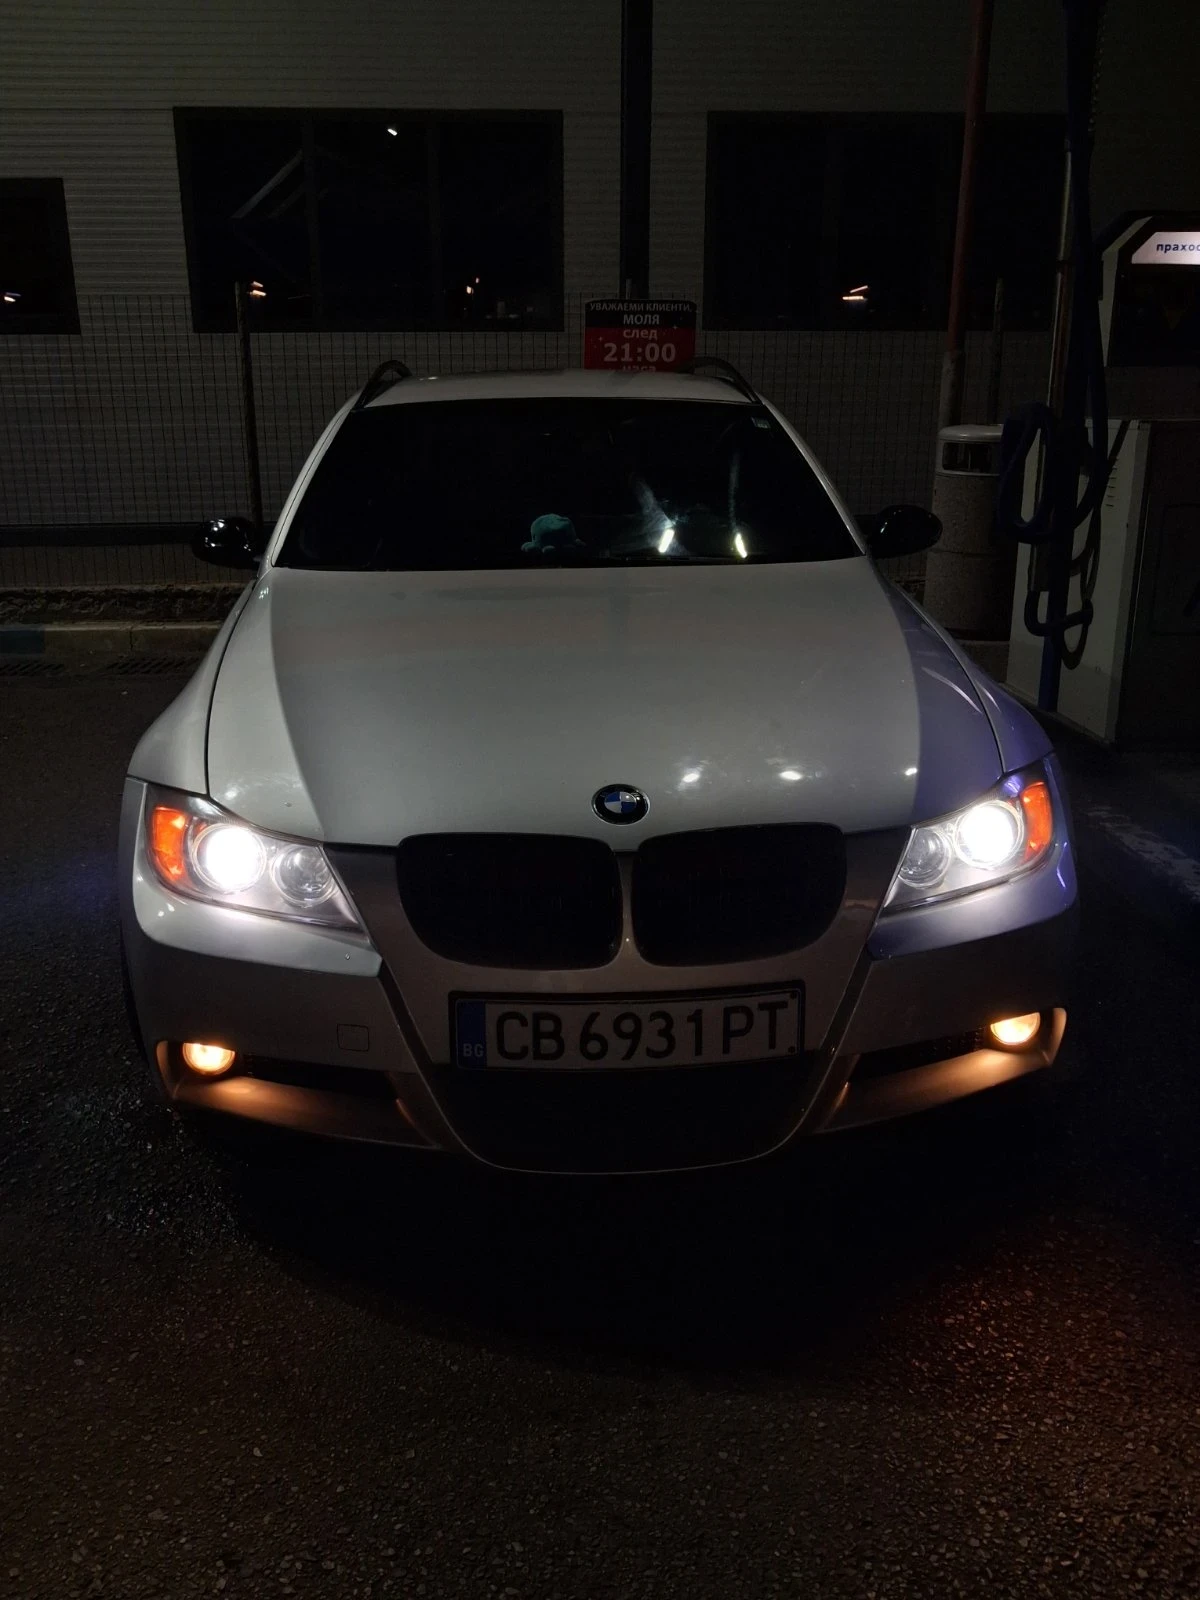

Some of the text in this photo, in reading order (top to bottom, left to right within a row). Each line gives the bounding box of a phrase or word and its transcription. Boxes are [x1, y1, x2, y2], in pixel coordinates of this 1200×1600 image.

[590, 302, 644, 311] УВАЖАЕМИ
[623, 314, 660, 325] МОЛЯ
[623, 329, 658, 341] след
[603, 343, 677, 363] 21:00
[496, 1000, 788, 1061] CB 6931 PT
[462, 1043, 485, 1058] BG
